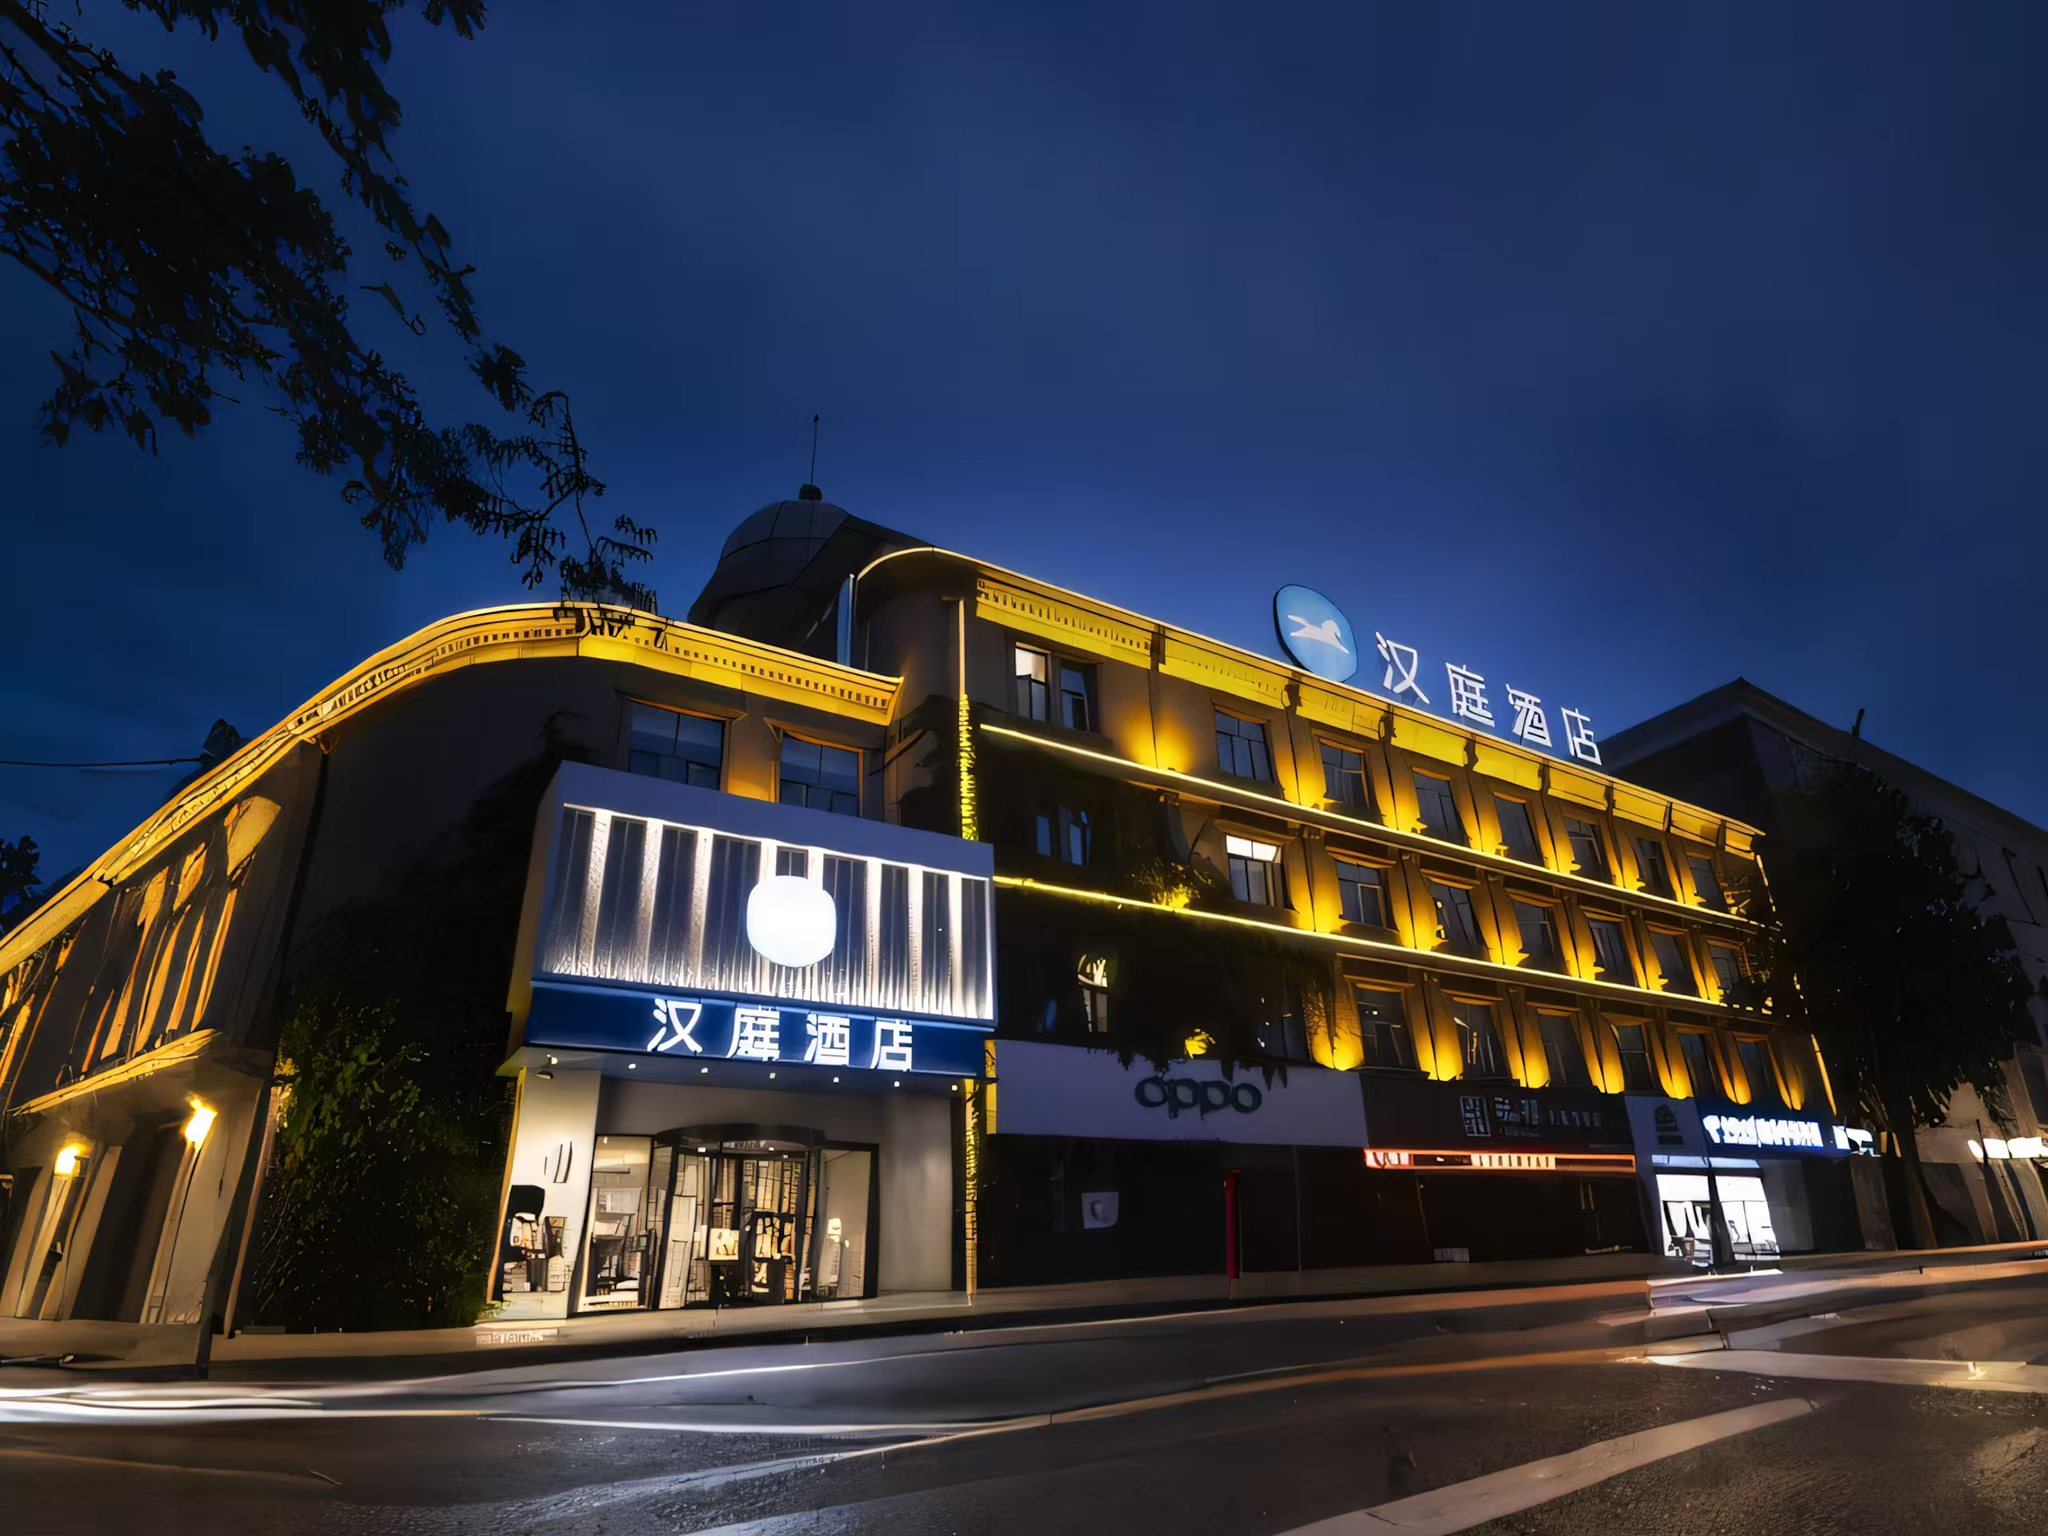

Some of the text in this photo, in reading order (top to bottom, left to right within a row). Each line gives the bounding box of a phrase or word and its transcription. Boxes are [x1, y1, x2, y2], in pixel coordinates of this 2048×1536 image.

[1375, 631, 1602, 765] 汉庭酒店
[647, 998, 912, 1072] 汉庭酒店
